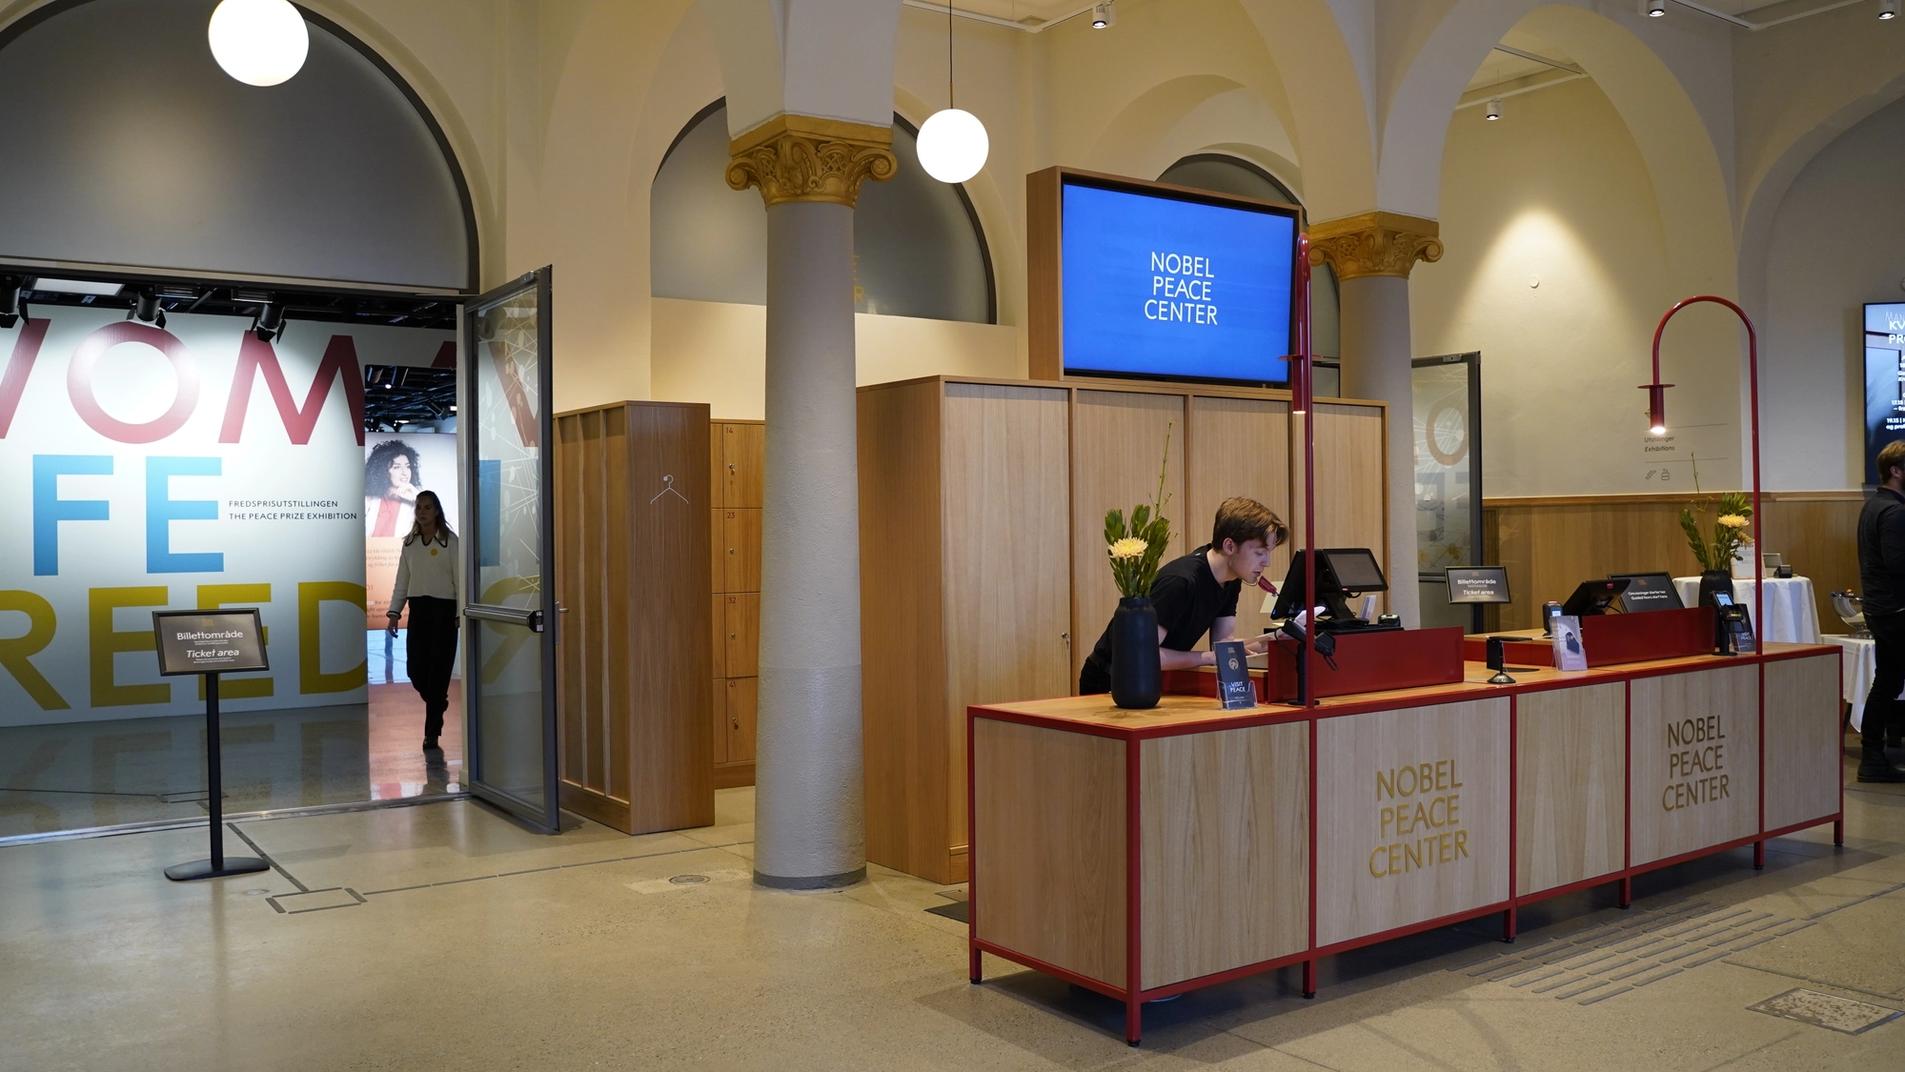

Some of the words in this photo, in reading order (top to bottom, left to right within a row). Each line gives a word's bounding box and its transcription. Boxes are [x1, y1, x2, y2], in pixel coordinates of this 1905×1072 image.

[1151, 251, 1215, 278] NOBEL
[1153, 275, 1212, 301] PEACE
[1144, 299, 1218, 325] CENTER
[229, 500, 338, 508] FREDSPRISUTSTILLINGEN
[229, 512, 247, 520] THE
[249, 512, 278, 520] PEACE
[280, 512, 305, 520] PRIZE
[307, 512, 357, 520] EXHIBITION
[176, 630, 244, 641] Billettområde
[186, 649, 216, 658] Ticket
[217, 649, 240, 657] area
[1668, 714, 1726, 748] NOBEL
[1670, 745, 1724, 779] PEACE
[1376, 759, 1463, 802] NOBEL
[1662, 774, 1730, 812] CENTER
[1380, 794, 1460, 839] PEACE
[1369, 829, 1470, 879] CENTER
